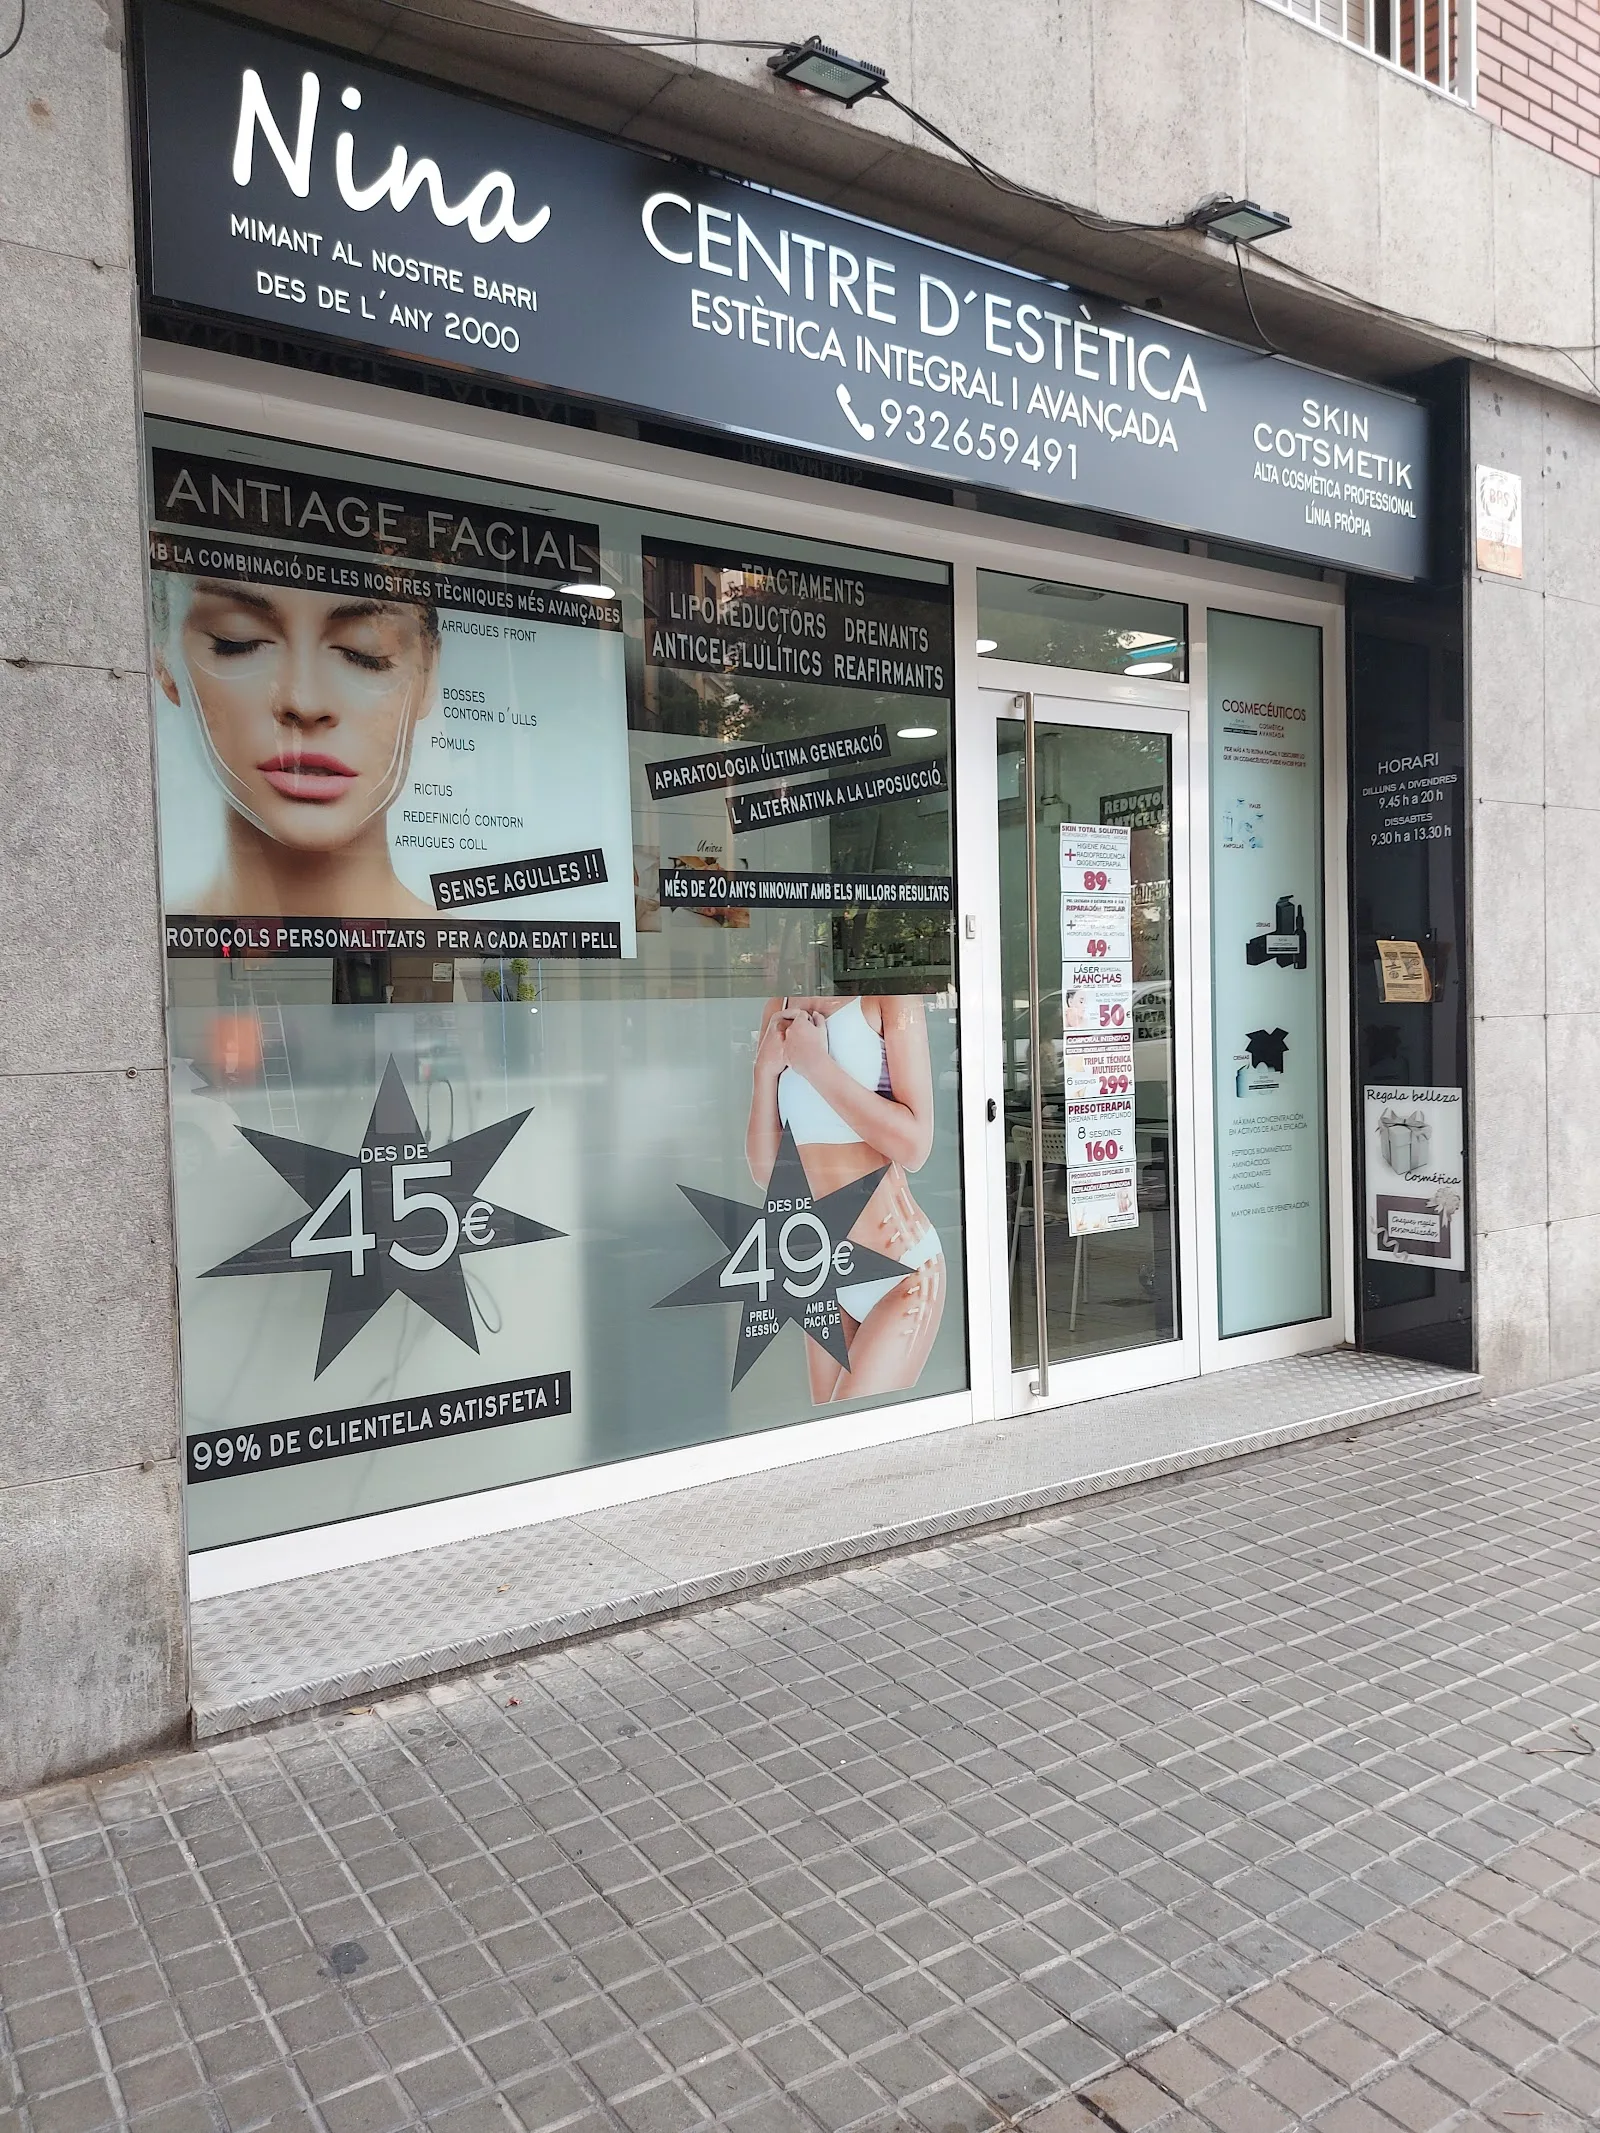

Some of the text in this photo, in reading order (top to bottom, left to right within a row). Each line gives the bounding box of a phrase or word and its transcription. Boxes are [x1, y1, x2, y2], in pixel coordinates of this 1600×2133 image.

[233, 69, 551, 243] Nina
[231, 214, 538, 312] MIMANT AL NOSTRE BARRI
[641, 192, 897, 325] CENTRE
[257, 270, 306, 304] DES
[318, 285, 349, 314] DE
[445, 312, 520, 354] 2000
[690, 288, 847, 368] ESTÈTICA
[856, 335, 1003, 408] INTEGRAL
[1026, 383, 1179, 452] AVANÇADA
[1302, 399, 1369, 442] SKIN
[880, 399, 1078, 480] 932659491
[1253, 423, 1413, 490] COTSMETIK
[1253, 461, 1417, 519] ALTA COSMÈTICA PROFESSIONAL
[166, 468, 593, 574] ANTIAGE FACIAL
[1334, 513, 1371, 538] PRÒPIA
[174, 545, 195, 565] LA
[199, 547, 302, 580] COMBINACIÓ
[306, 562, 327, 583] DE
[331, 567, 360, 589] LES
[364, 572, 431, 598] NOSTRES
[435, 576, 514, 610] TÈCNIQUES
[518, 587, 545, 613] MÉS
[548, 598, 621, 626] AVANÇADES
[742, 562, 865, 607] TRACTAMENTS
[441, 620, 537, 643] ARRUGUES FRONT
[669, 592, 929, 653] LIPOREDUCTORS DRENANTS
[834, 655, 944, 691] REAFIRMANTS
[443, 688, 485, 704] BOSSES
[444, 706, 494, 723] CONTORN
[1222, 699, 1306, 721] COSMECÉUTICOS
[431, 730, 476, 753] PÒMULS
[654, 732, 883, 791] APARATOLOGIA ÚLTIMA GENERACIÓ
[1378, 752, 1439, 775] HORARI
[414, 782, 453, 798] RICTUS
[836, 790, 845, 804] A
[848, 787, 863, 801] LA
[865, 762, 942, 798] LIPOSUCCIÓ
[1362, 774, 1457, 796] DILLUNS A DIVENDRES
[1379, 789, 1444, 809] 9.45 h a 20 h
[403, 808, 525, 830] REDEFINICIÓ CONTORN
[1078, 826, 1096, 834] TOTAL
[1384, 813, 1433, 827] DISSABTES
[395, 834, 488, 851] ARRUGUES COLL
[1370, 825, 1452, 846] 9.30 h a 13.30 h
[438, 871, 501, 904] SENSE
[503, 862, 581, 893] AGULLES
[664, 871, 949, 902] MÉS DE 20 ANYS INNOVANT AMB ELS MILLORS RESULTATS
[276, 928, 426, 949] PERSONALITZATS
[437, 930, 470, 950] PER
[473, 932, 485, 950] A
[487, 932, 529, 950] CADA
[532, 933, 570, 950] EDAT
[581, 933, 618, 950] PELL
[1073, 964, 1099, 973] LÁSER
[1073, 973, 1122, 984] MANCHAS
[1084, 1054, 1131, 1066] TRIPLE TÉCNICA
[1367, 1089, 1460, 1103] Regala belleza
[1068, 1101, 1131, 1115] PRESOTERAPIA
[1068, 1111, 1132, 1123] DRENANTE PROFUNDO
[1077, 1126, 1122, 1140] 8 SESIONES
[360, 1143, 429, 1163] DES DE
[1404, 1171, 1462, 1185] Cosmética
[767, 1197, 812, 1213] DES DE
[749, 1309, 775, 1323] PREU
[805, 1300, 838, 1315] AMB EL
[804, 1313, 840, 1328] PACK DE
[822, 1327, 829, 1340] 6
[193, 1434, 261, 1471] 99%
[269, 1430, 301, 1457] DE
[308, 1407, 433, 1450] CLIENTELA
[438, 1387, 548, 1425] SATISFETA
